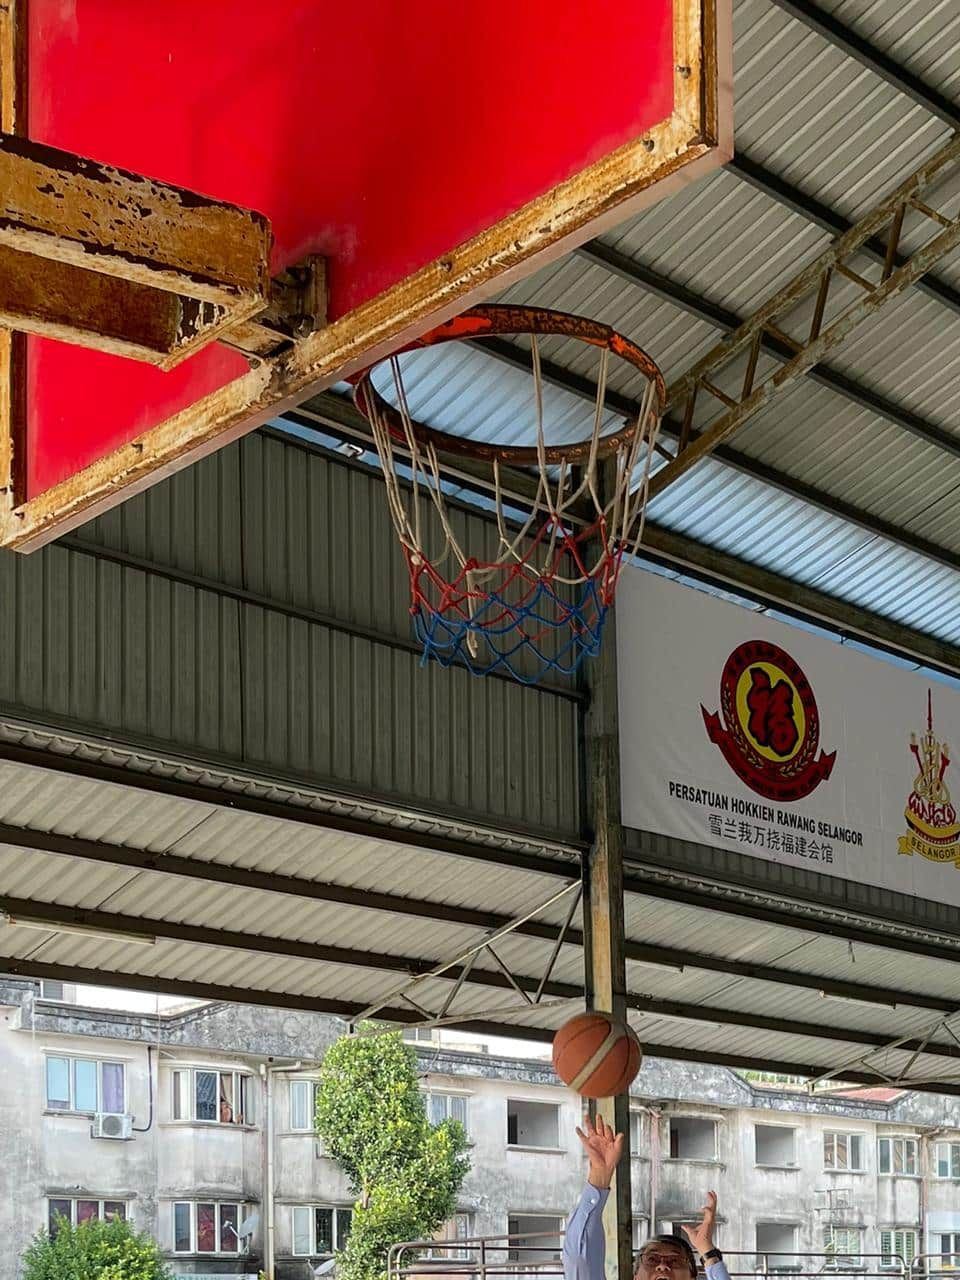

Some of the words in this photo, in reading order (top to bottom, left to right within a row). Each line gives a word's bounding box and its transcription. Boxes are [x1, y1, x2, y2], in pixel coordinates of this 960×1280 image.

[668, 781, 729, 811] PERSATUAN
[731, 798, 775, 824] HOKKIEN
[777, 810, 816, 834] RAWANG
[817, 822, 864, 847] SELANGOR
[708, 813, 833, 864] 雪兰莪万挠福建会馆
[911, 836, 957, 859] SELANGOR
